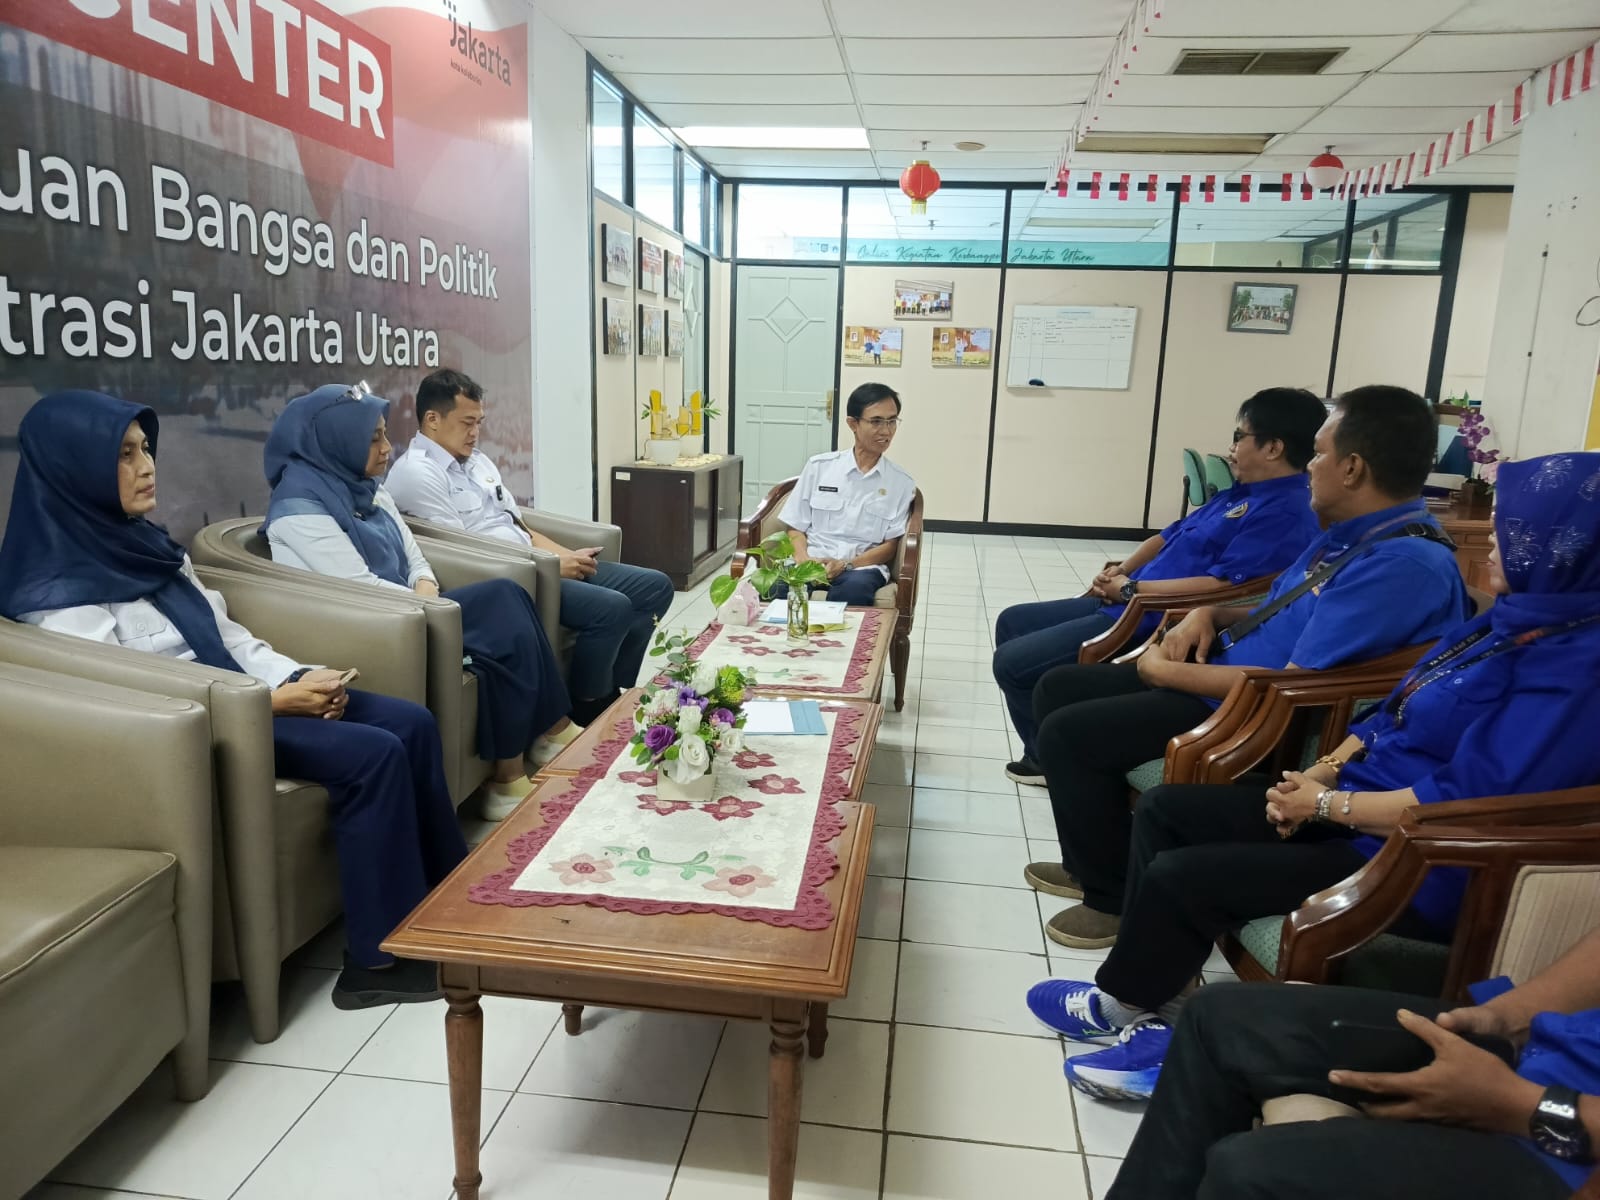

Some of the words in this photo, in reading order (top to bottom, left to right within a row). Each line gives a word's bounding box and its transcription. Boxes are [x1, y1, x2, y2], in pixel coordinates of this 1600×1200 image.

[67, 0, 386, 140] NTER
[152, 165, 335, 275] Bangsa
[347, 219, 409, 283] dan
[420, 238, 498, 299] Politik
[171, 289, 343, 364] Jakarta
[356, 311, 439, 367] Utara
